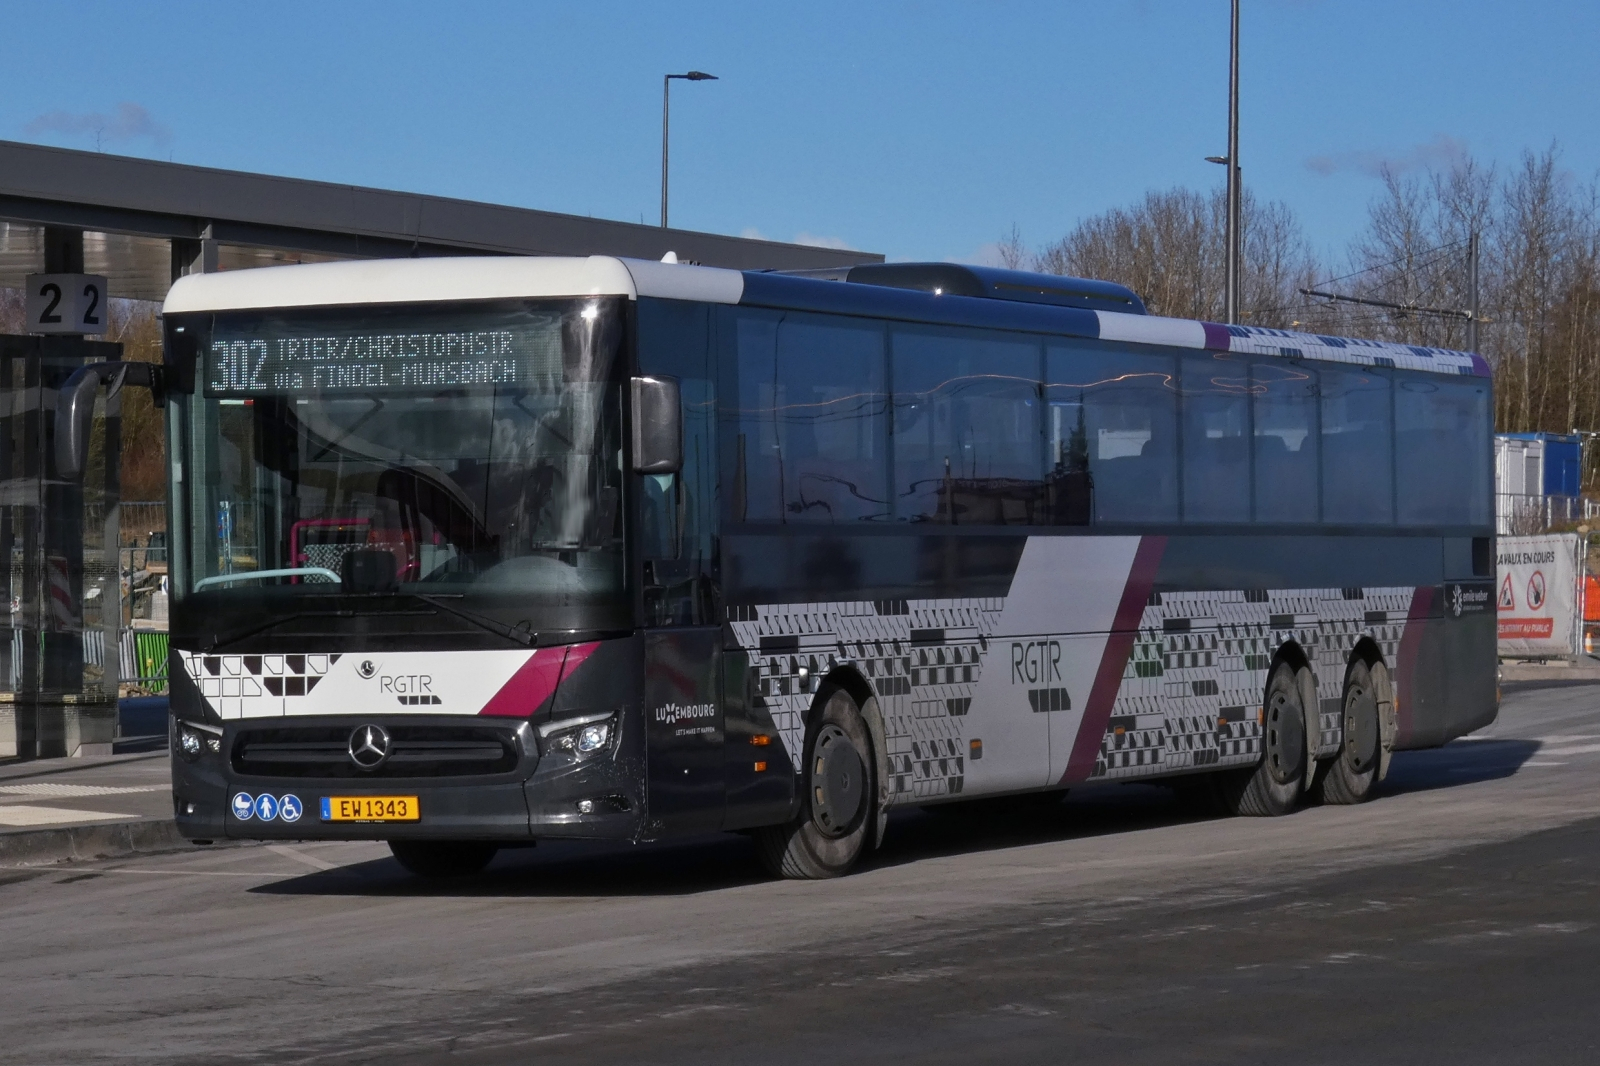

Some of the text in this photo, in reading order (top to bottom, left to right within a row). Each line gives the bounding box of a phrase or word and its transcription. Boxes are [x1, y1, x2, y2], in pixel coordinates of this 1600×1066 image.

[39, 283, 62, 323] 2
[83, 284, 99, 324] 2
[277, 332, 512, 360] TRIER/CHRISTOPHSTR
[211, 339, 267, 390] 302
[274, 360, 515, 389] via FINDEL-MUNSBACH
[1497, 551, 1554, 565] AVAUX EN COURS
[1012, 640, 1062, 685] RGTR
[380, 674, 433, 693] RGTR
[656, 703, 714, 723] LUXEMBOURG
